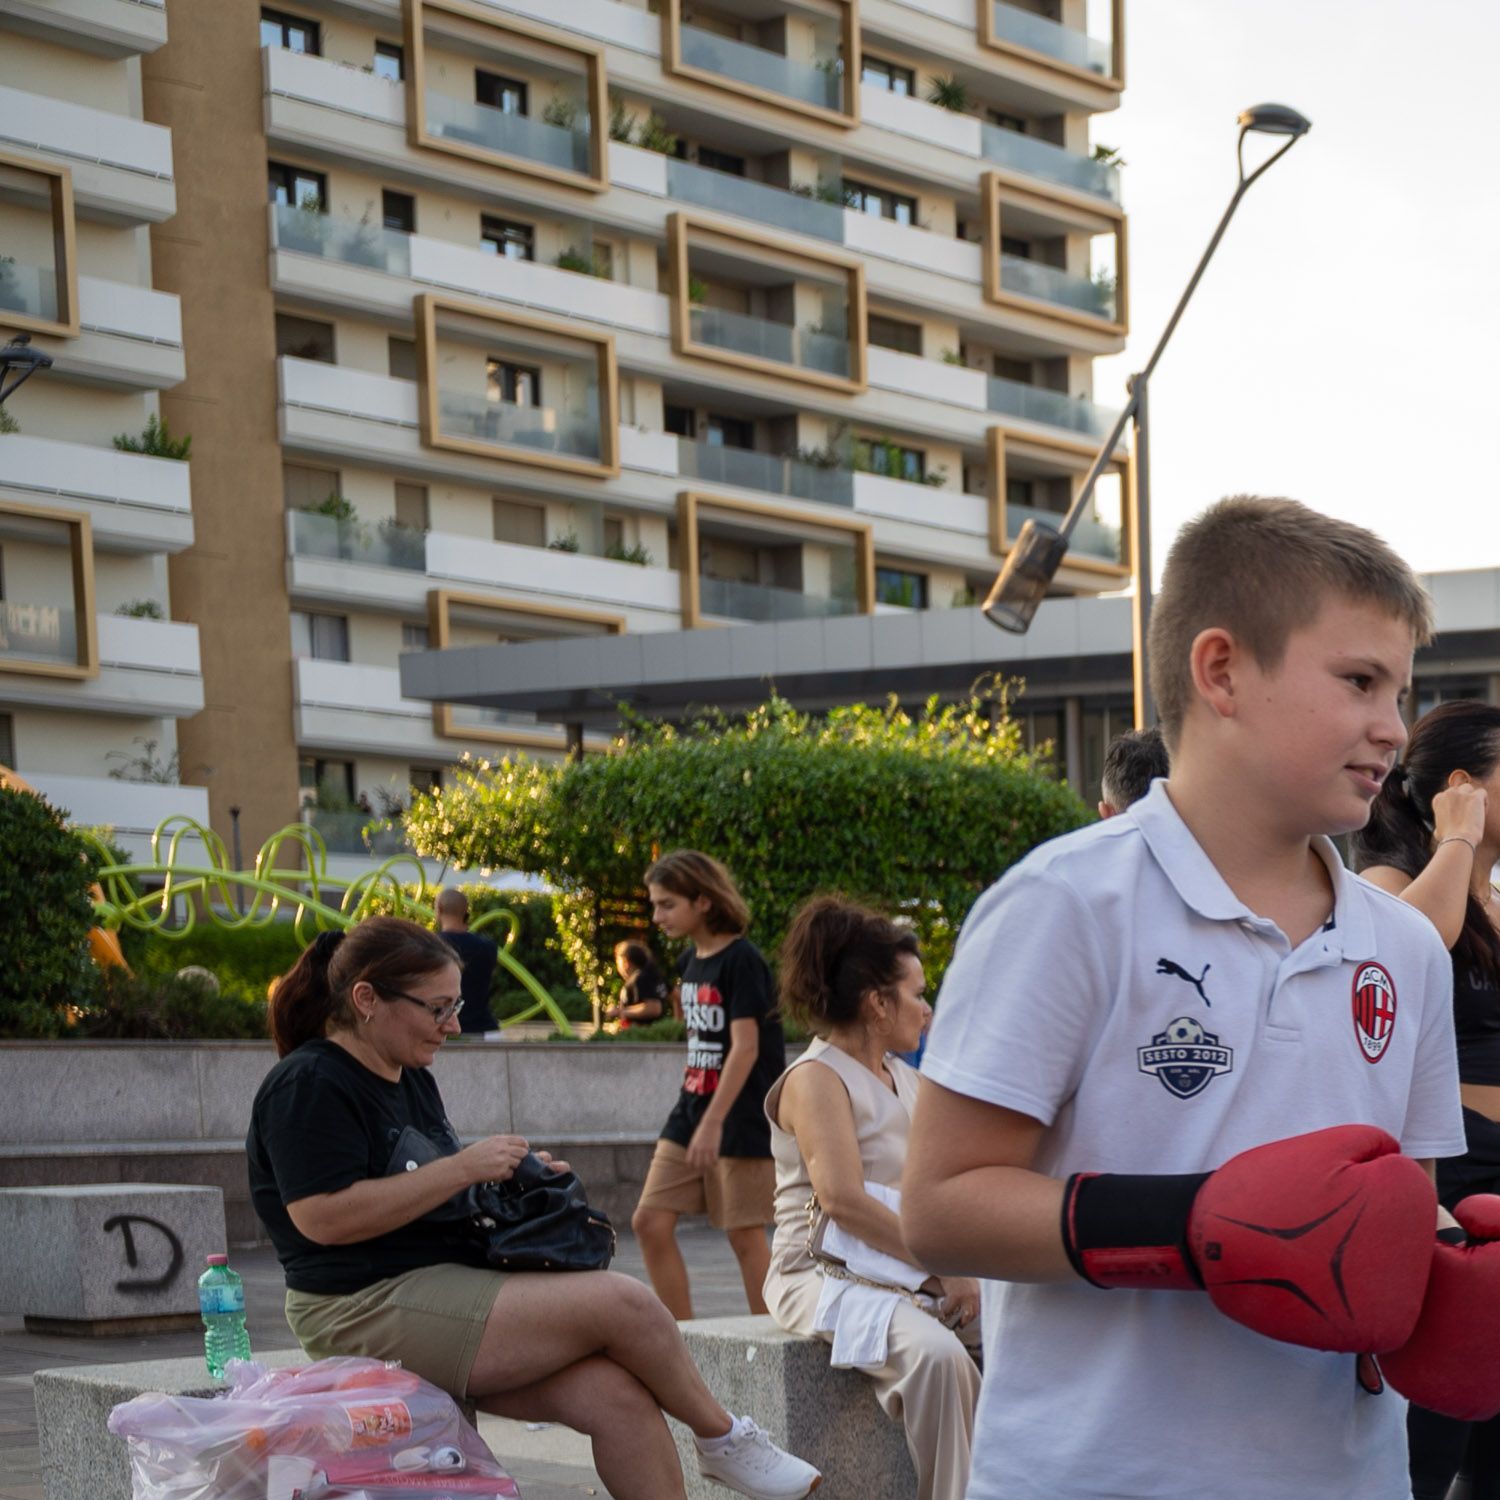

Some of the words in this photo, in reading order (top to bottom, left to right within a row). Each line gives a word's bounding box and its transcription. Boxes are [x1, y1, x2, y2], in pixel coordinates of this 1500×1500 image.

[1362, 970, 1390, 990] ACM
[1364, 1037, 1382, 1052] 1899
[1145, 1049, 1188, 1062] SESTO
[1193, 1049, 1226, 1062] 2012
[103, 1214, 184, 1294] D
